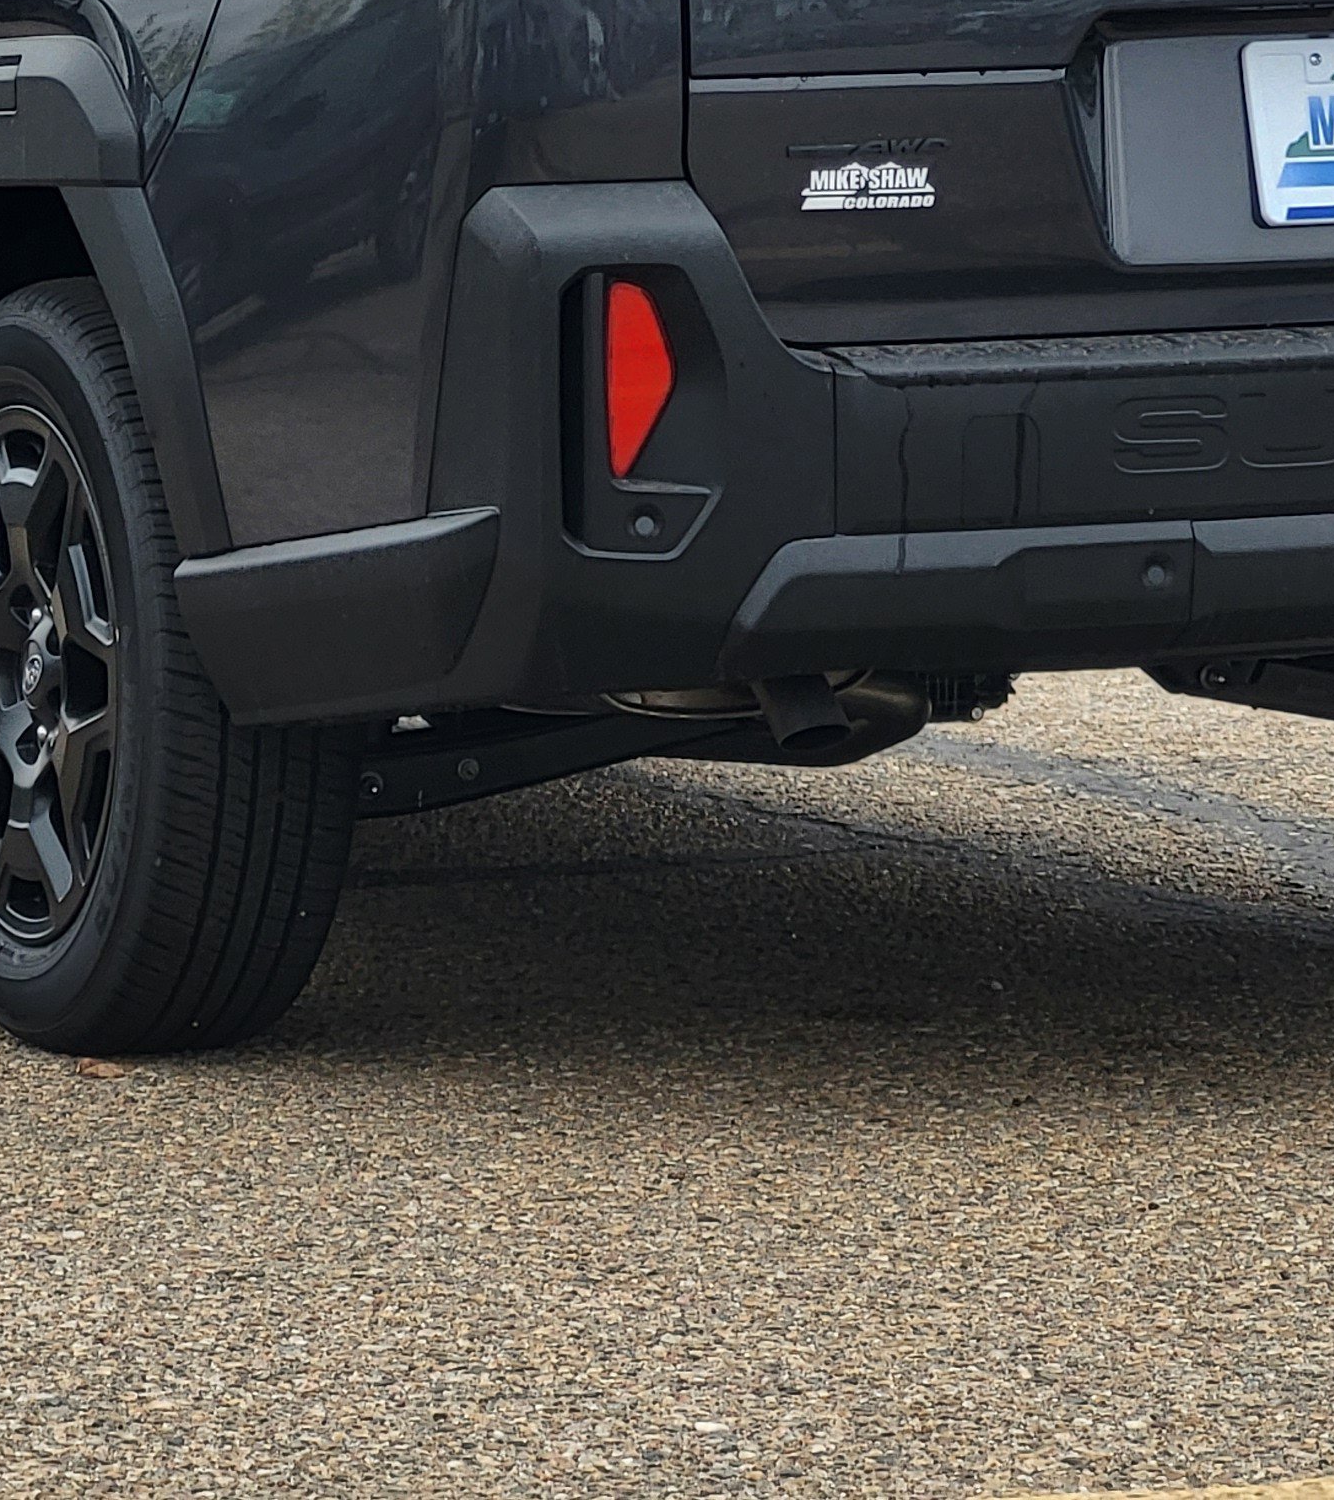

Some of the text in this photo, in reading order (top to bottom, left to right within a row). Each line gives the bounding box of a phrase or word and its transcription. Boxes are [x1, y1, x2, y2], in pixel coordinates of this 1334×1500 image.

[810, 167, 929, 191] MIKE SHAW
[843, 194, 936, 210] COLORADO
